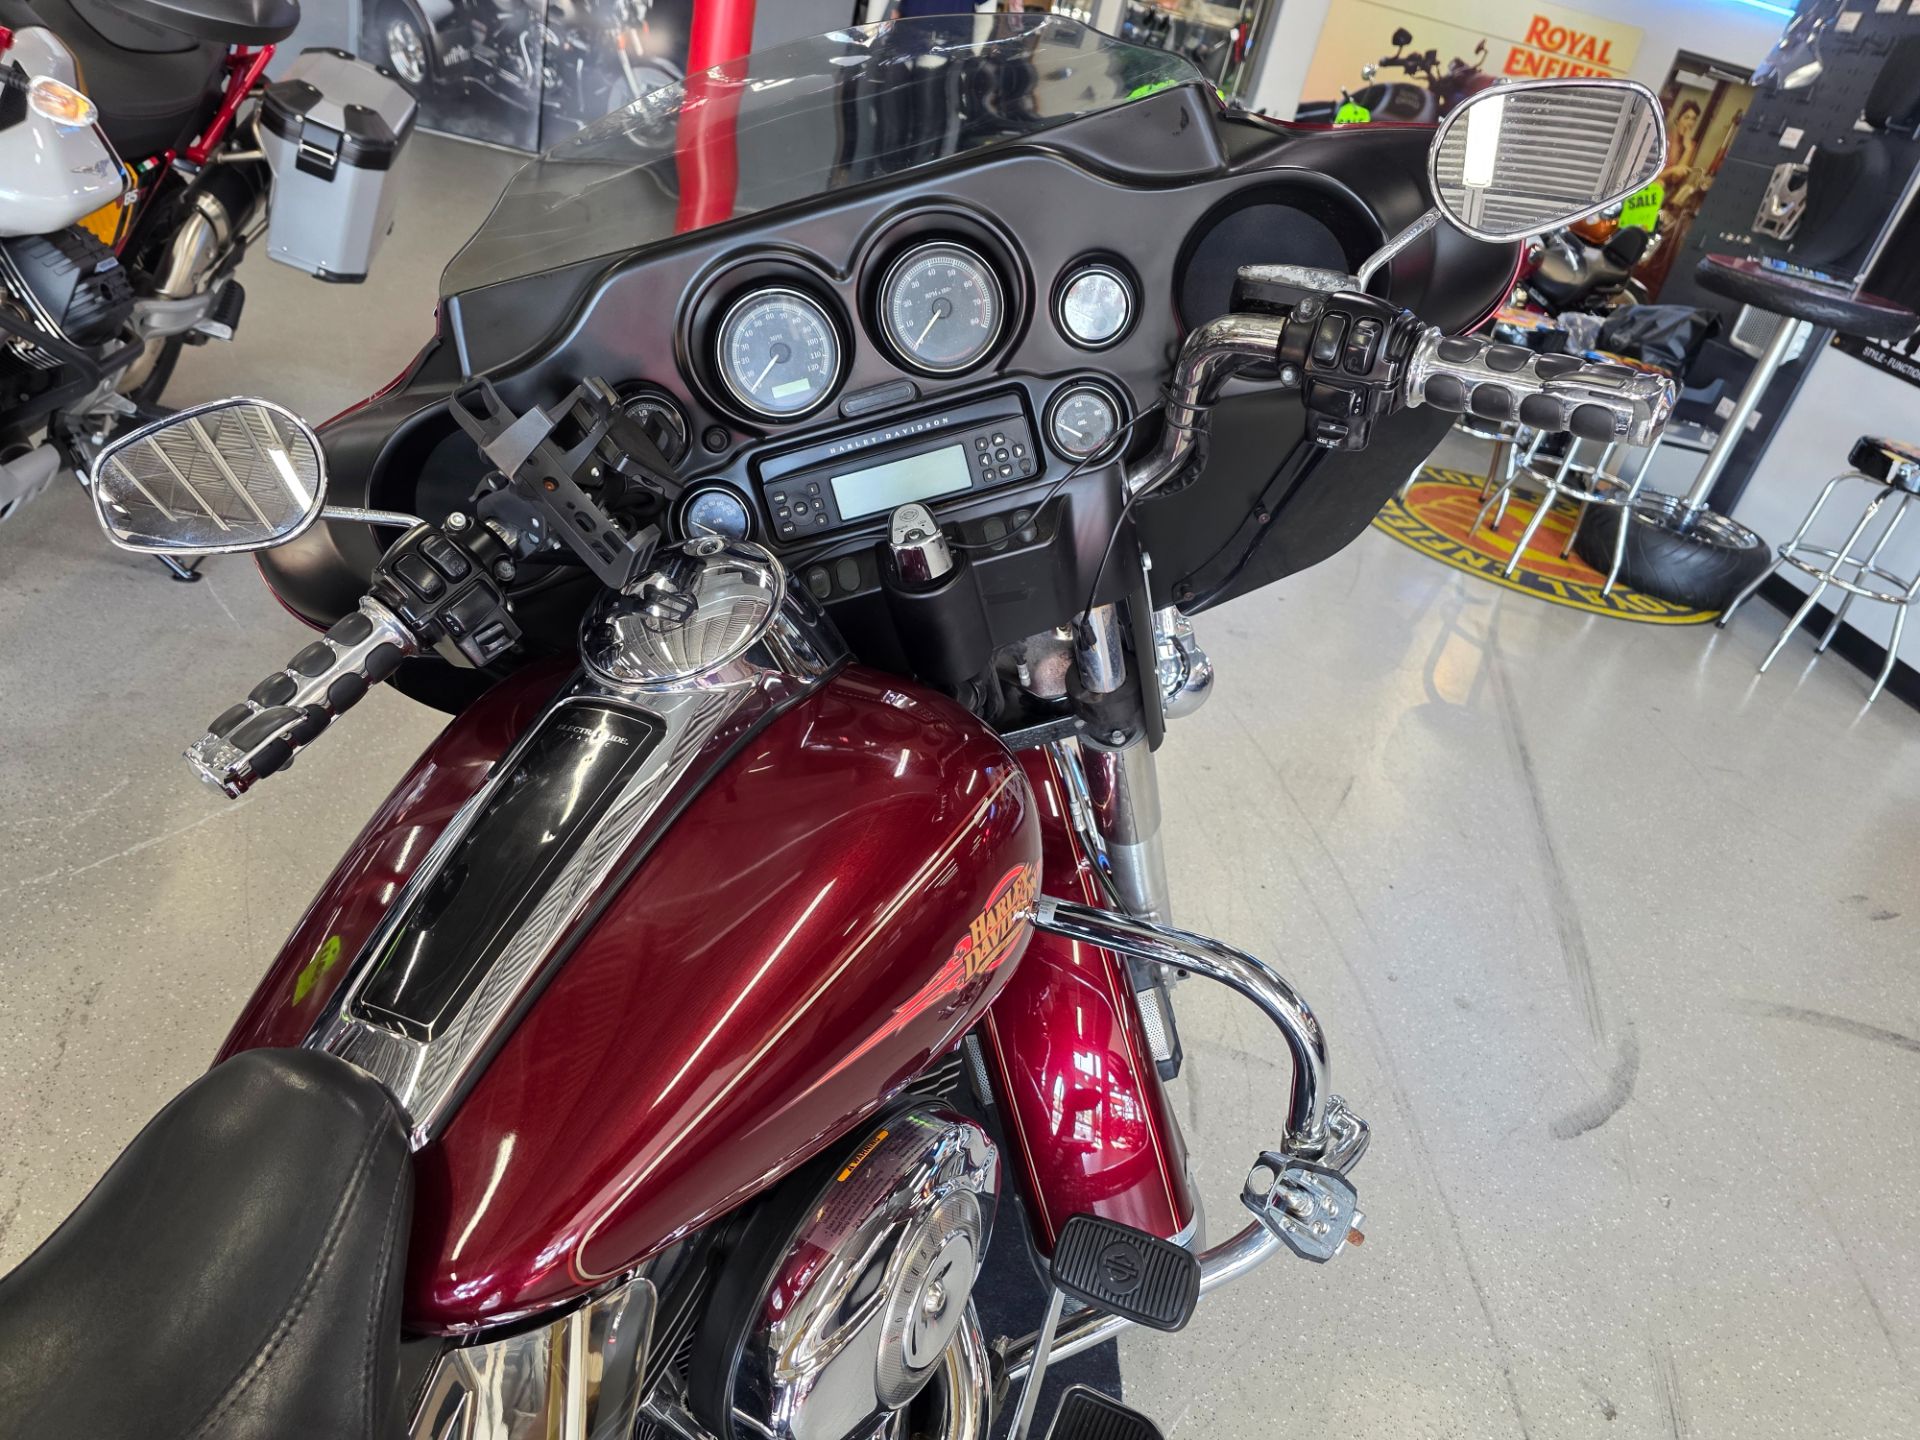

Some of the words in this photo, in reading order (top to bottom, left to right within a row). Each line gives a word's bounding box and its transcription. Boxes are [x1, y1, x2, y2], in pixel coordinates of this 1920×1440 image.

[1525, 15, 1612, 65] ROYAL
[1503, 46, 1612, 78] ENFIE
[1628, 192, 1657, 209] SALE
[556, 724, 599, 739] ELECTR
[854, 1135, 882, 1167] WARNING
